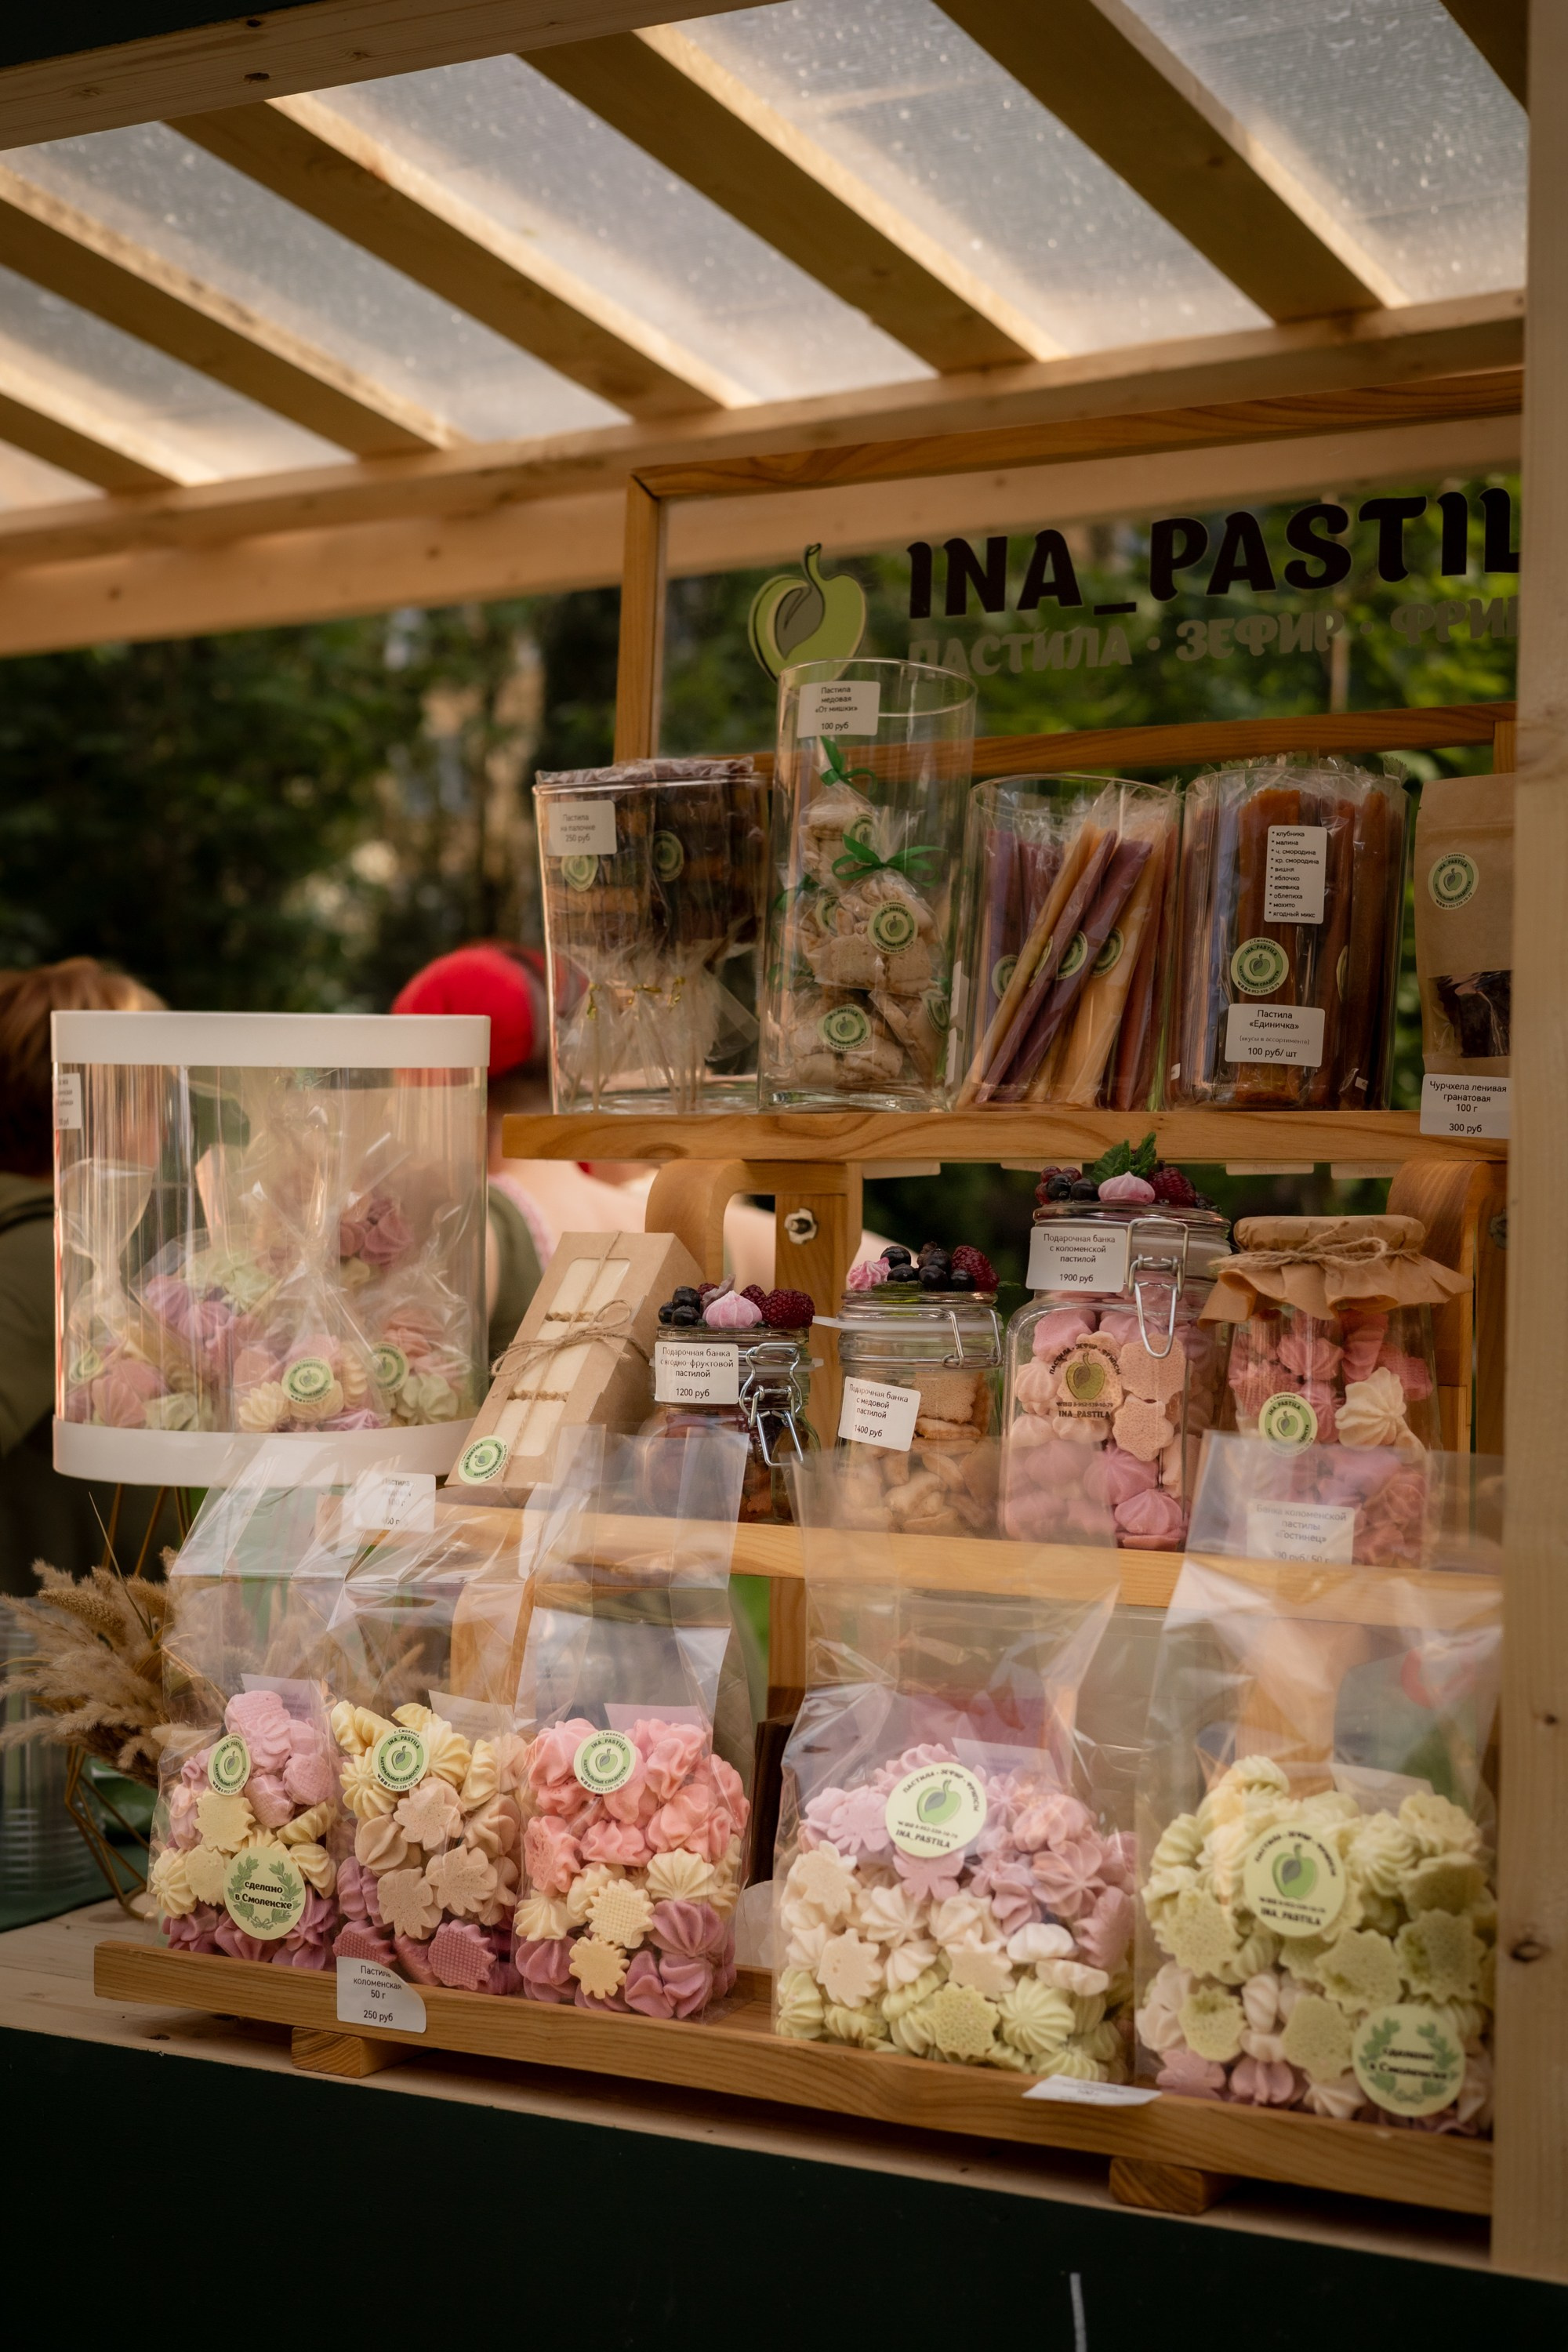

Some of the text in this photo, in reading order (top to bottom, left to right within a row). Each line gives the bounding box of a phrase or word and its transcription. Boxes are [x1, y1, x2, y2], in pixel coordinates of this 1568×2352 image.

[907, 627, 1132, 680] ПАСТИЛА
[1176, 610, 1344, 660] ЗЕФИР
[835, 721, 849, 731] руб
[578, 833, 590, 844] руб
[1244, 945, 1278, 956] INA_PASTILA
[1257, 1009, 1293, 1018] Пастила
[1249, 1020, 1299, 1029] «Единичка»
[1265, 1036, 1310, 1045] ассортименте)
[1265, 1048, 1284, 1058] руб/
[1430, 1081, 1469, 1091] Чурчхела
[1443, 1094, 1490, 1102] гранатовая
[1467, 1124, 1483, 1134] руб
[1044, 1233, 1116, 1243] Подарочная банка
[1080, 1275, 1093, 1283] руб
[662, 1347, 731, 1357] Подарочная банка
[664, 1359, 734, 1368] ягодно-фруктовой
[1049, 1347, 1073, 1375] ПАСТИЛА
[1102, 1349, 1121, 1375] ФРИПСЫ
[695, 1389, 710, 1399] руб
[849, 1384, 909, 1403] Подарочная банка
[860, 1398, 890, 1409] медовой
[857, 1407, 887, 1419] пастилой
[854, 1425, 883, 1438] 1400 руб
[1257, 1504, 1347, 1521] Банка коломенской
[1282, 1521, 1321, 1530] пастилы
[221, 1741, 243, 1752] INA_PASTILA
[387, 1736, 420, 1749] INA_PASTILA
[591, 1738, 626, 1751] INA_PASTILA
[400, 1764, 419, 1782] СЛАДОСТИ
[604, 1766, 626, 1784] СЛАДОСТИ
[902, 1771, 935, 1793] ПАСТИЛА
[896, 1829, 950, 1848] INA_PASTILA
[245, 1882, 283, 1893] сделано
[242, 1893, 292, 1909] Смоленске
[361, 1965, 391, 1977] Пастила
[353, 1978, 402, 1990] коломенская
[371, 1989, 380, 1998] 50
[363, 2009, 394, 2023] 250 руб
